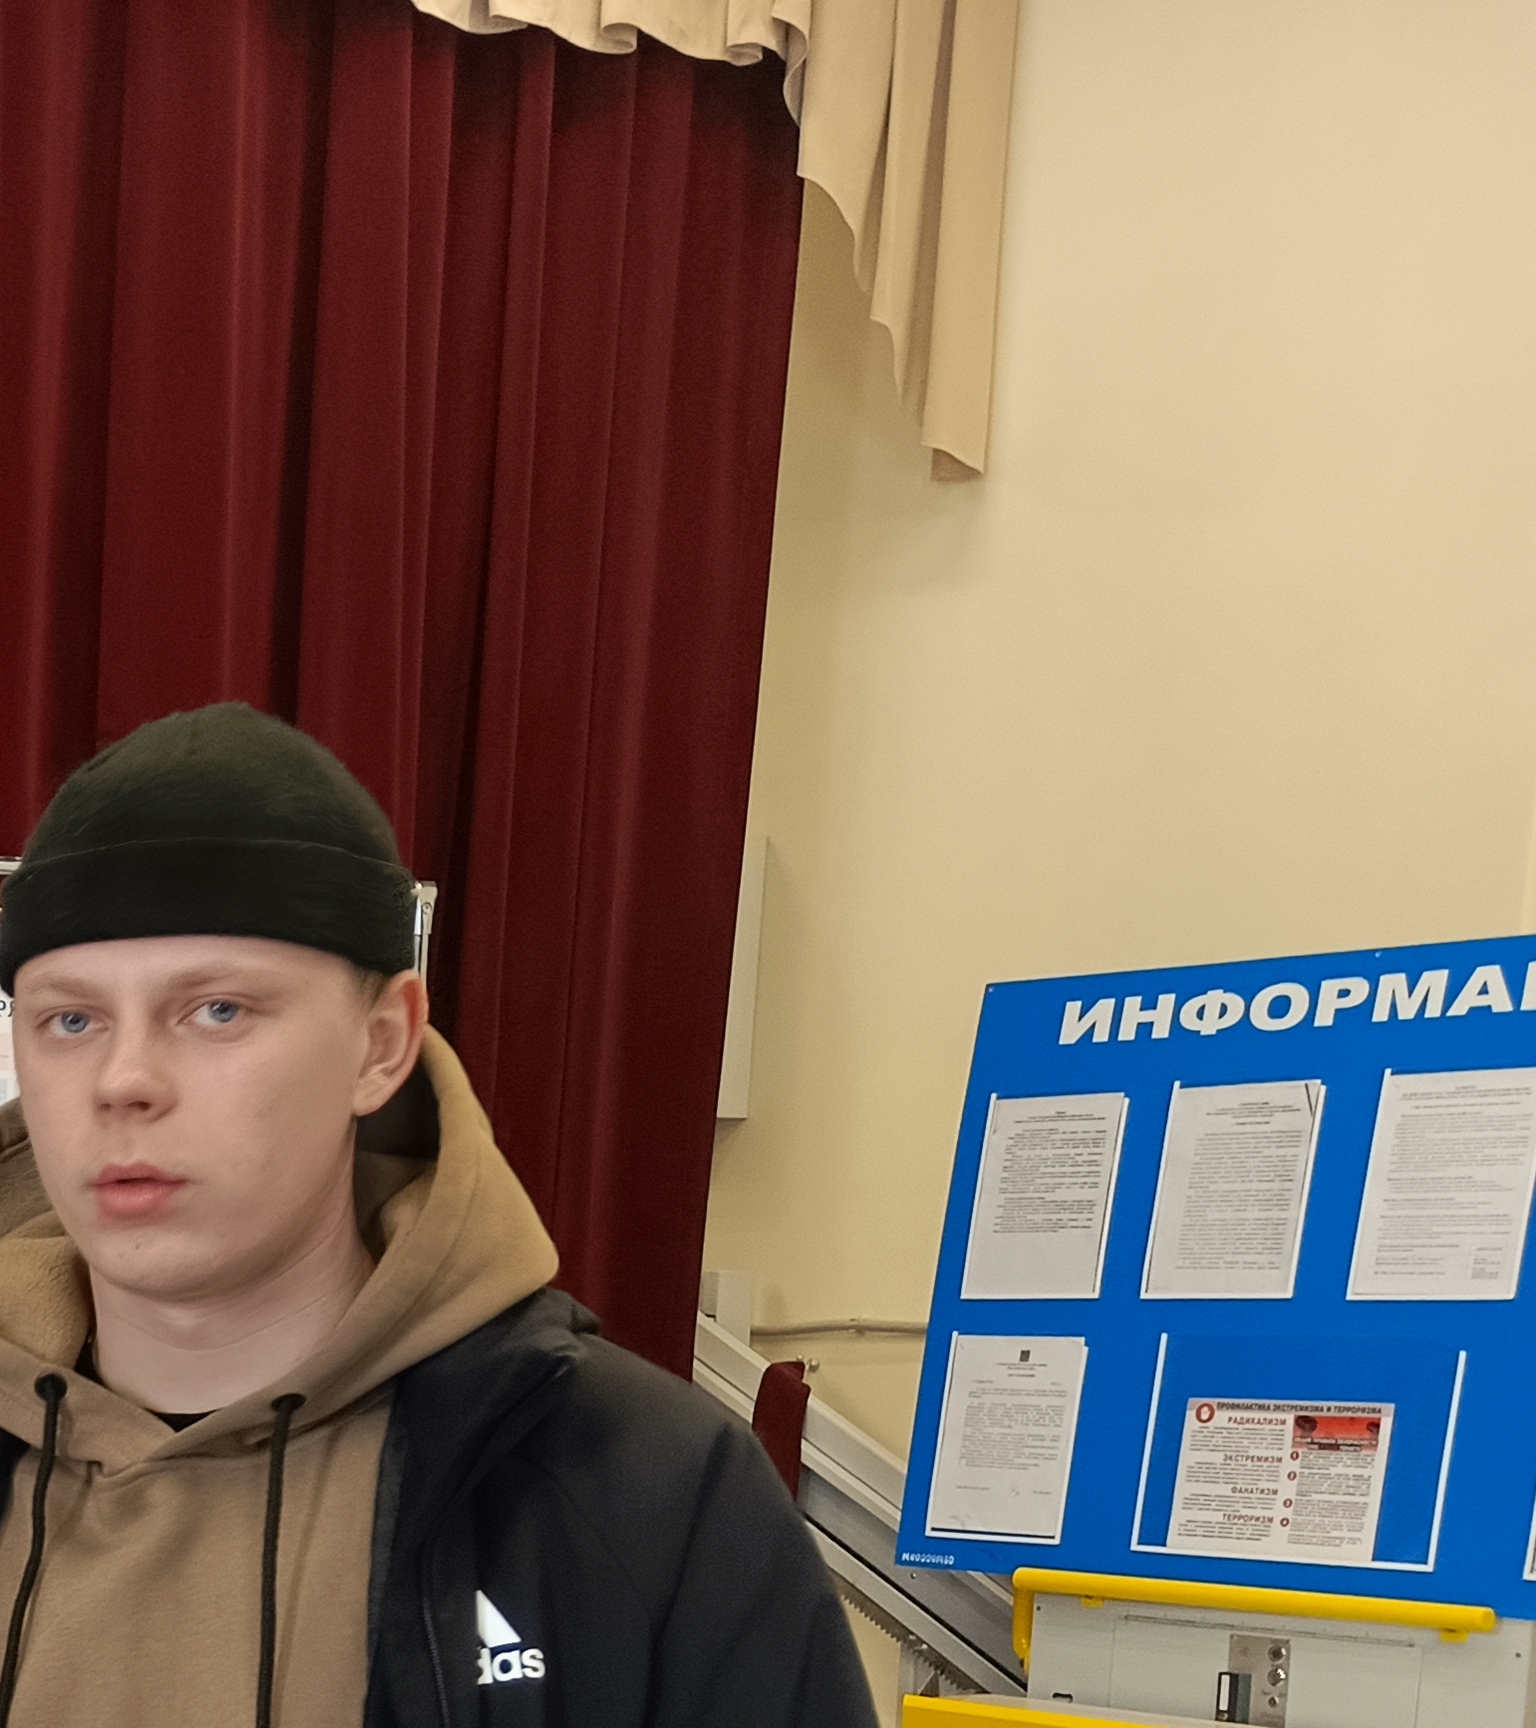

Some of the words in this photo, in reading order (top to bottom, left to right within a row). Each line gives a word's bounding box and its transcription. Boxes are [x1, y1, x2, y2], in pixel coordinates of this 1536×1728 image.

[1227, 1416, 1287, 1427] РАДИКАЛИЗМ
[1222, 1453, 1283, 1464] ЭКСТРЕМИЗМ
[1231, 1485, 1278, 1496] ФАНАТИЗМ
[1222, 1513, 1274, 1524] ТЕРРОРИЗМ
